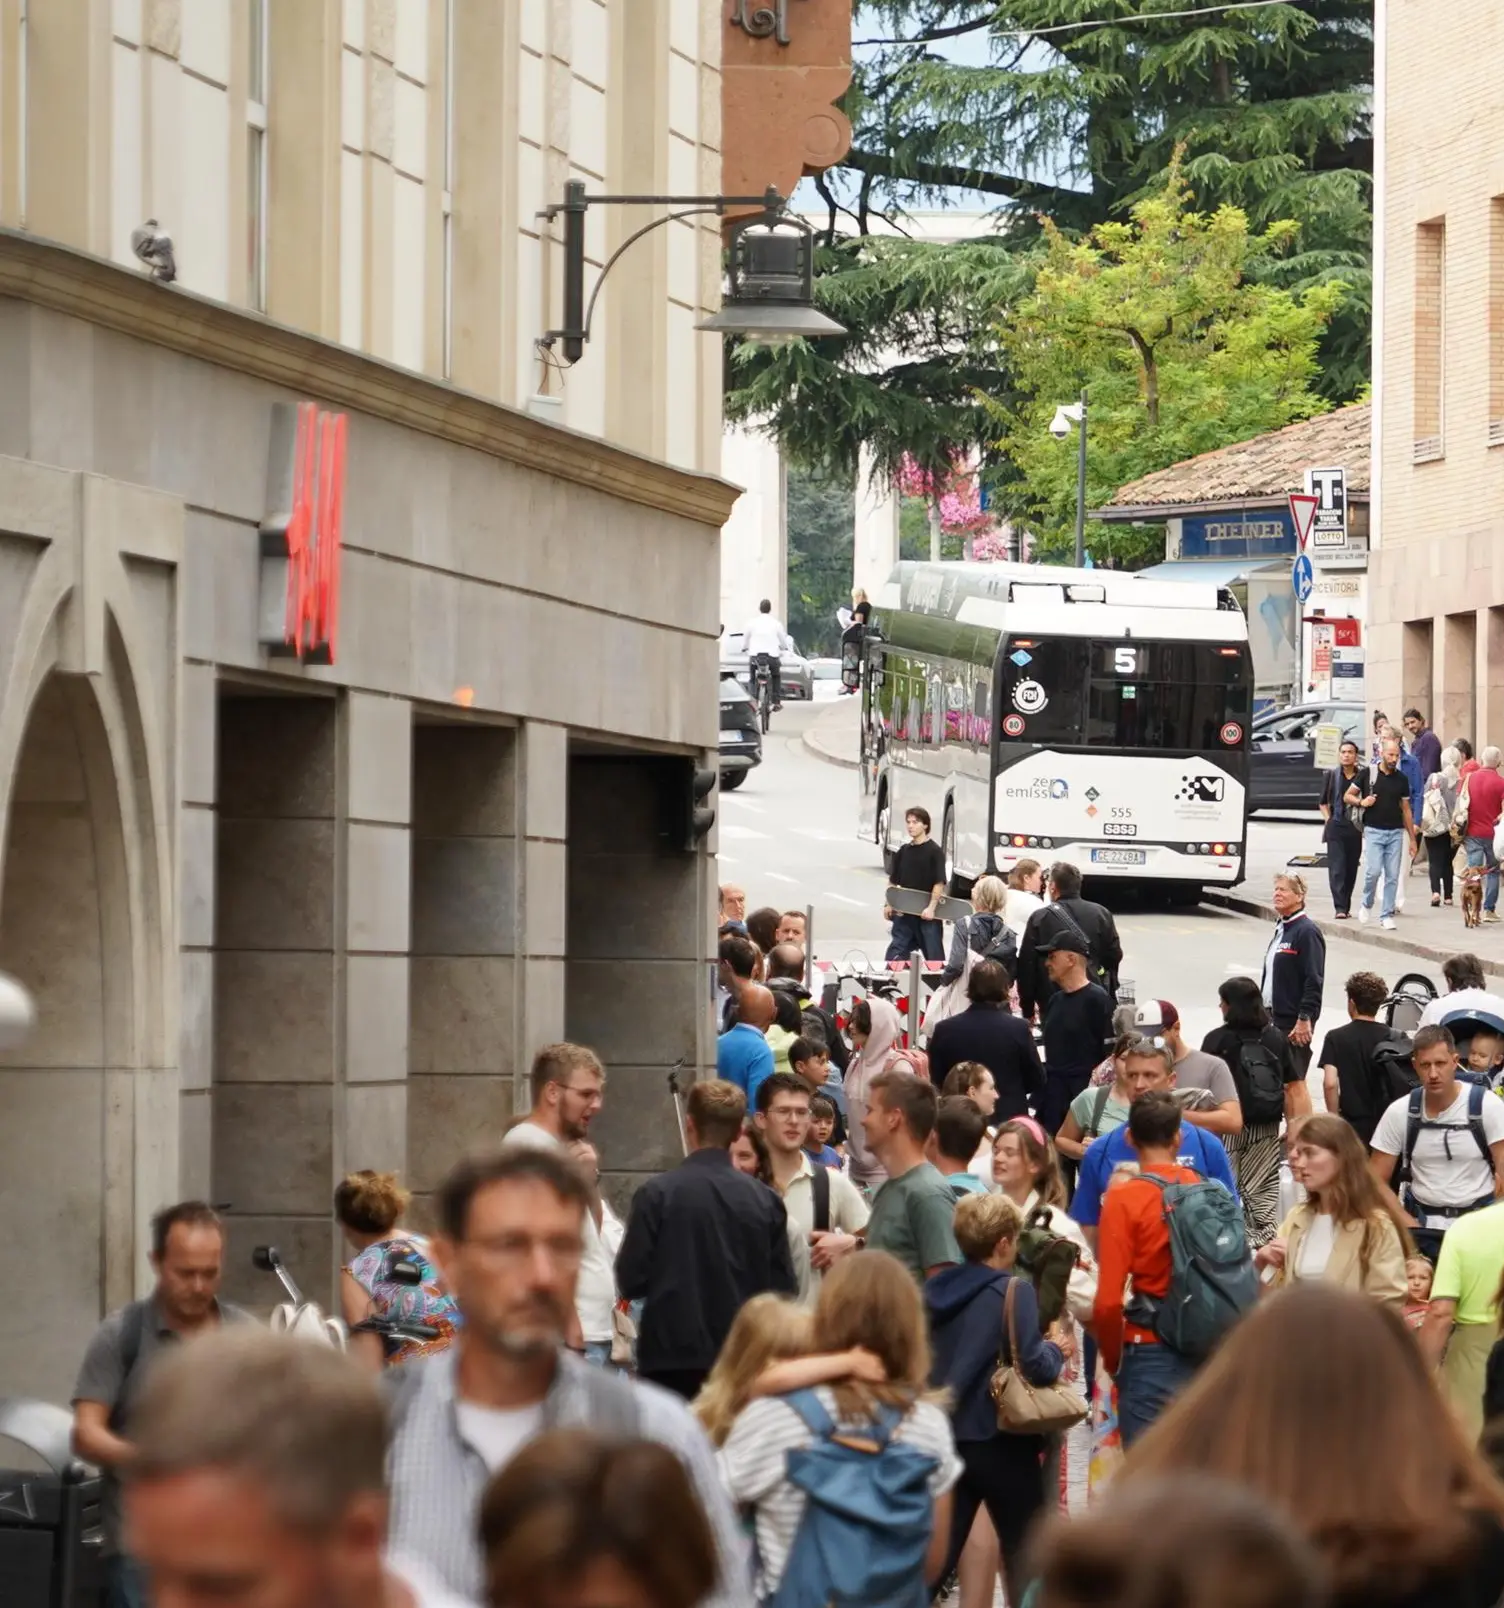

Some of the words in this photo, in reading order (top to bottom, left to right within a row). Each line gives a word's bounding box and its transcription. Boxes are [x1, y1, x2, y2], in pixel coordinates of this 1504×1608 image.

[1312, 471, 1342, 509] T
[1204, 521, 1284, 541] THEINER
[1114, 647, 1136, 673] 5
[1008, 720, 1020, 730] 80
[1111, 807, 1132, 818] 555
[1104, 823, 1136, 836] sasa
